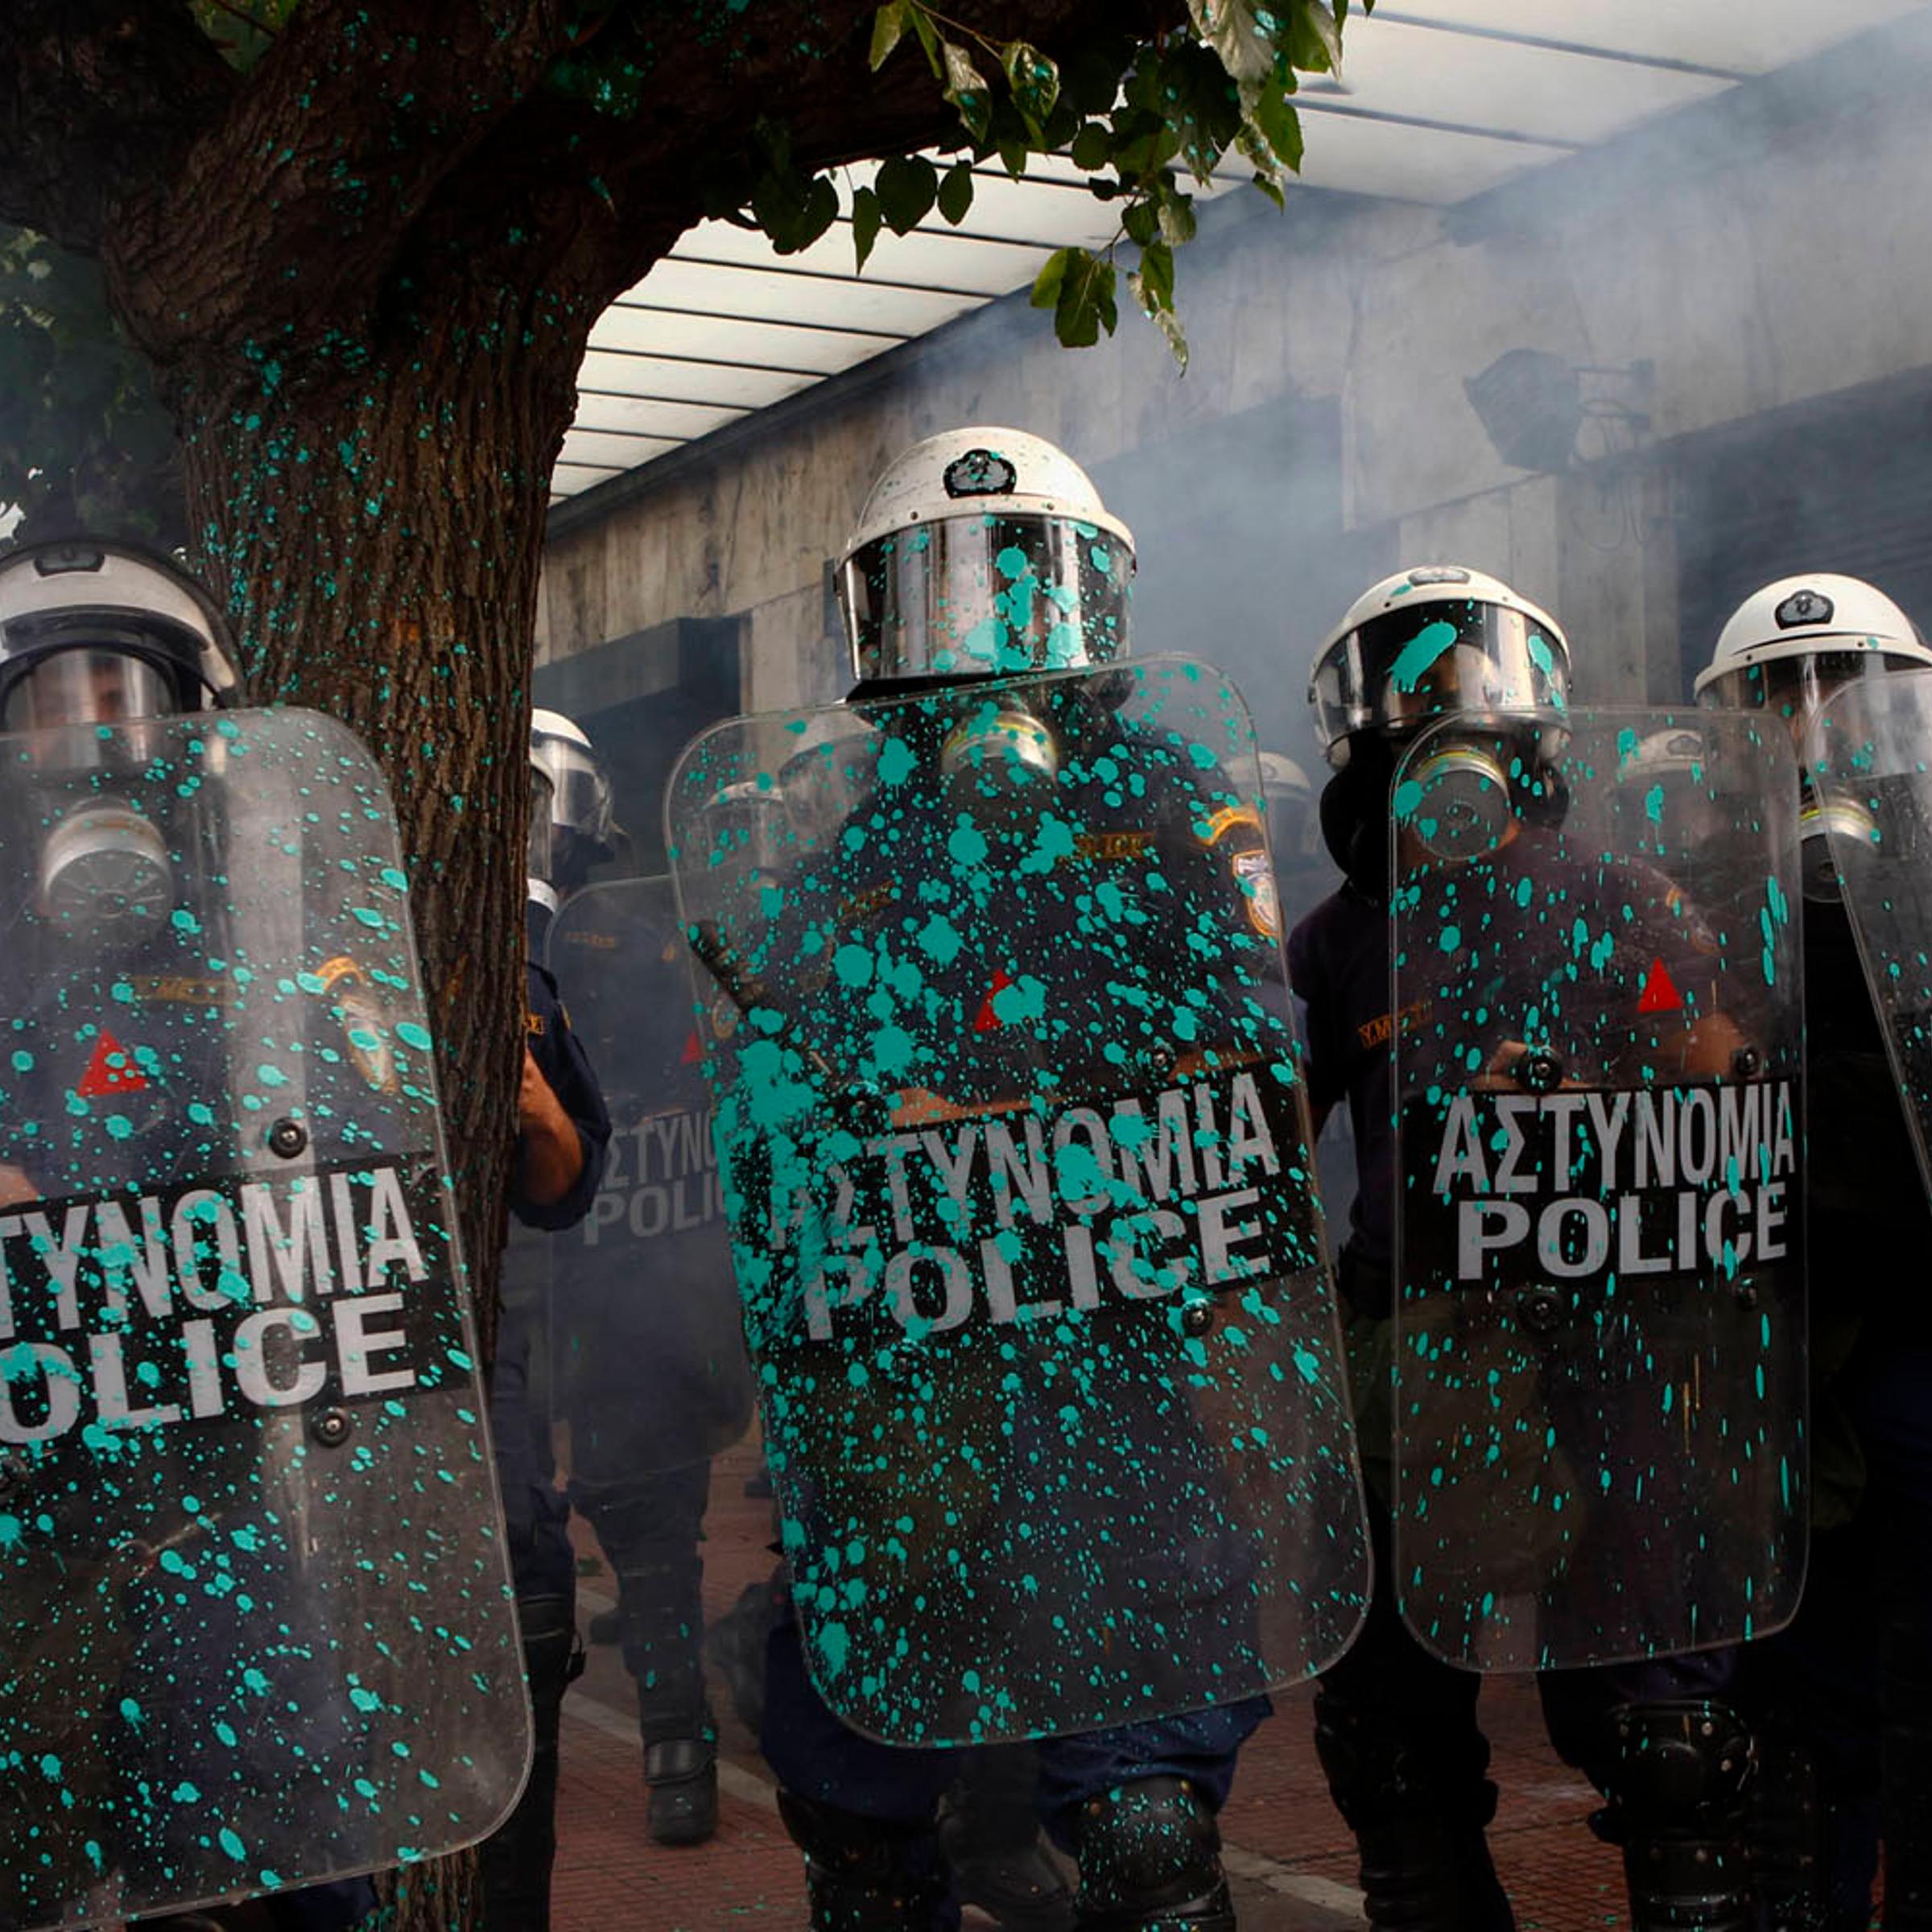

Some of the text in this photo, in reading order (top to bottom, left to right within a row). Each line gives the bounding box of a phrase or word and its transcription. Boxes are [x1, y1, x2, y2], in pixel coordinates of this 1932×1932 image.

[1432, 1080, 1795, 1195] ΑΣΤΥΝΟΜΙΑ
[584, 1172, 726, 1245] POLI
[1458, 1183, 1787, 1281] POLICE
[804, 1187, 1270, 1340] POLICE
